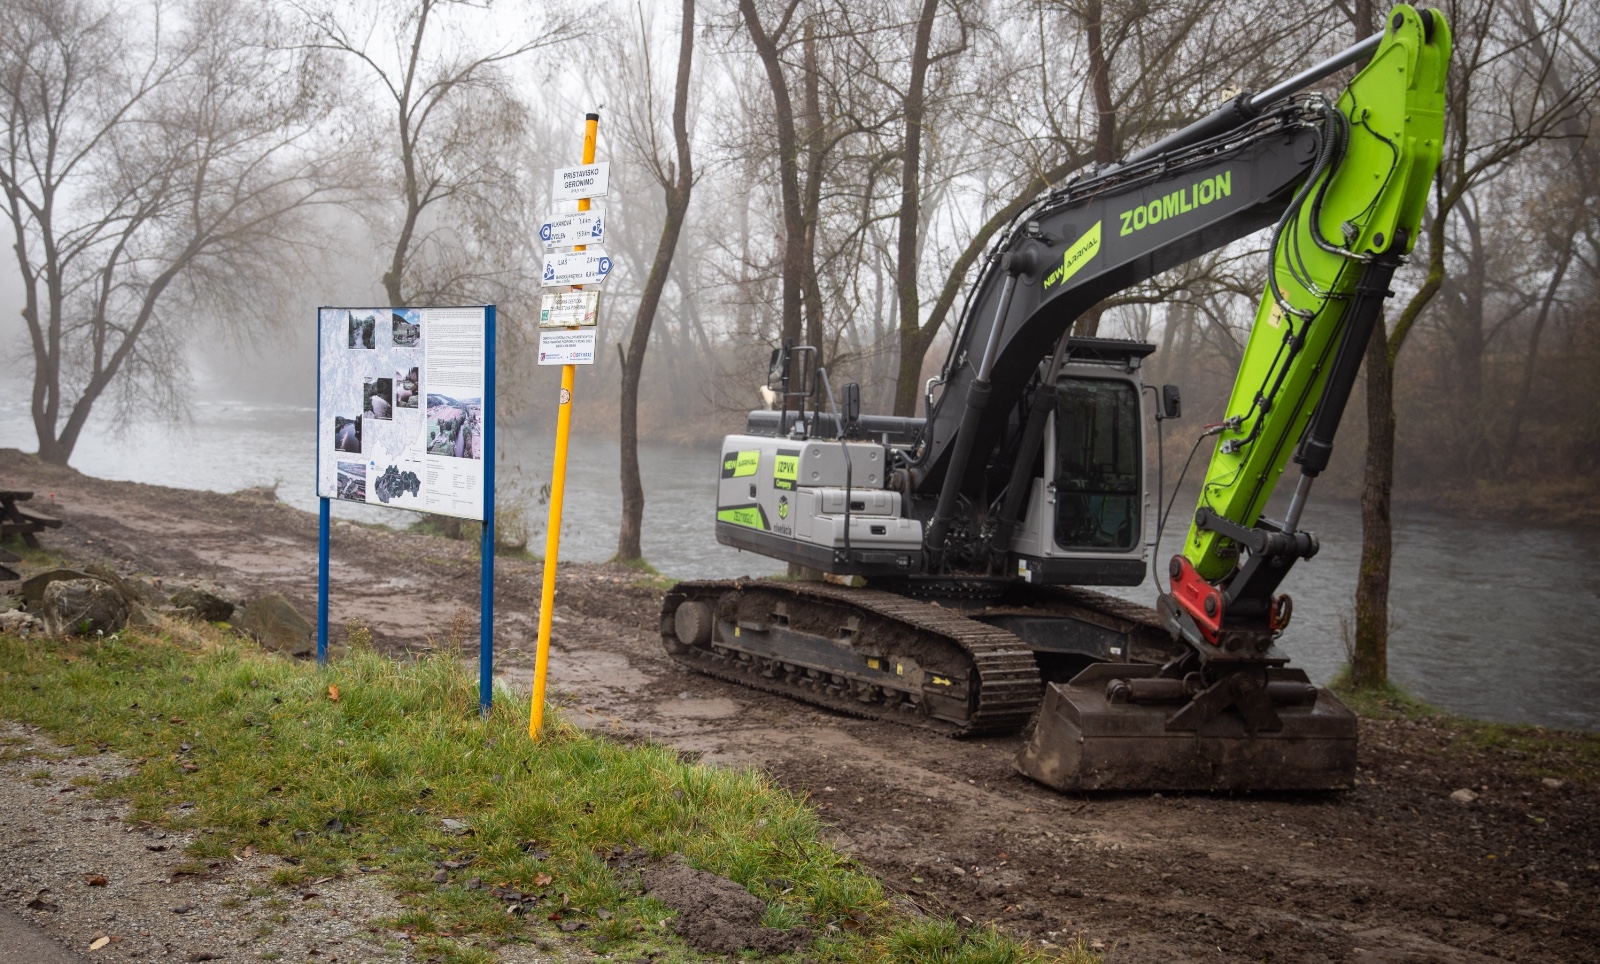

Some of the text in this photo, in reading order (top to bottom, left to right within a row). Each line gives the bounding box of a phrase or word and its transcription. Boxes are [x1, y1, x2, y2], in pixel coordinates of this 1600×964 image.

[1119, 171, 1232, 237] ZOOMLION
[1043, 237, 1098, 290] NEW ARRIVAL
[724, 460, 737, 470] NEW
